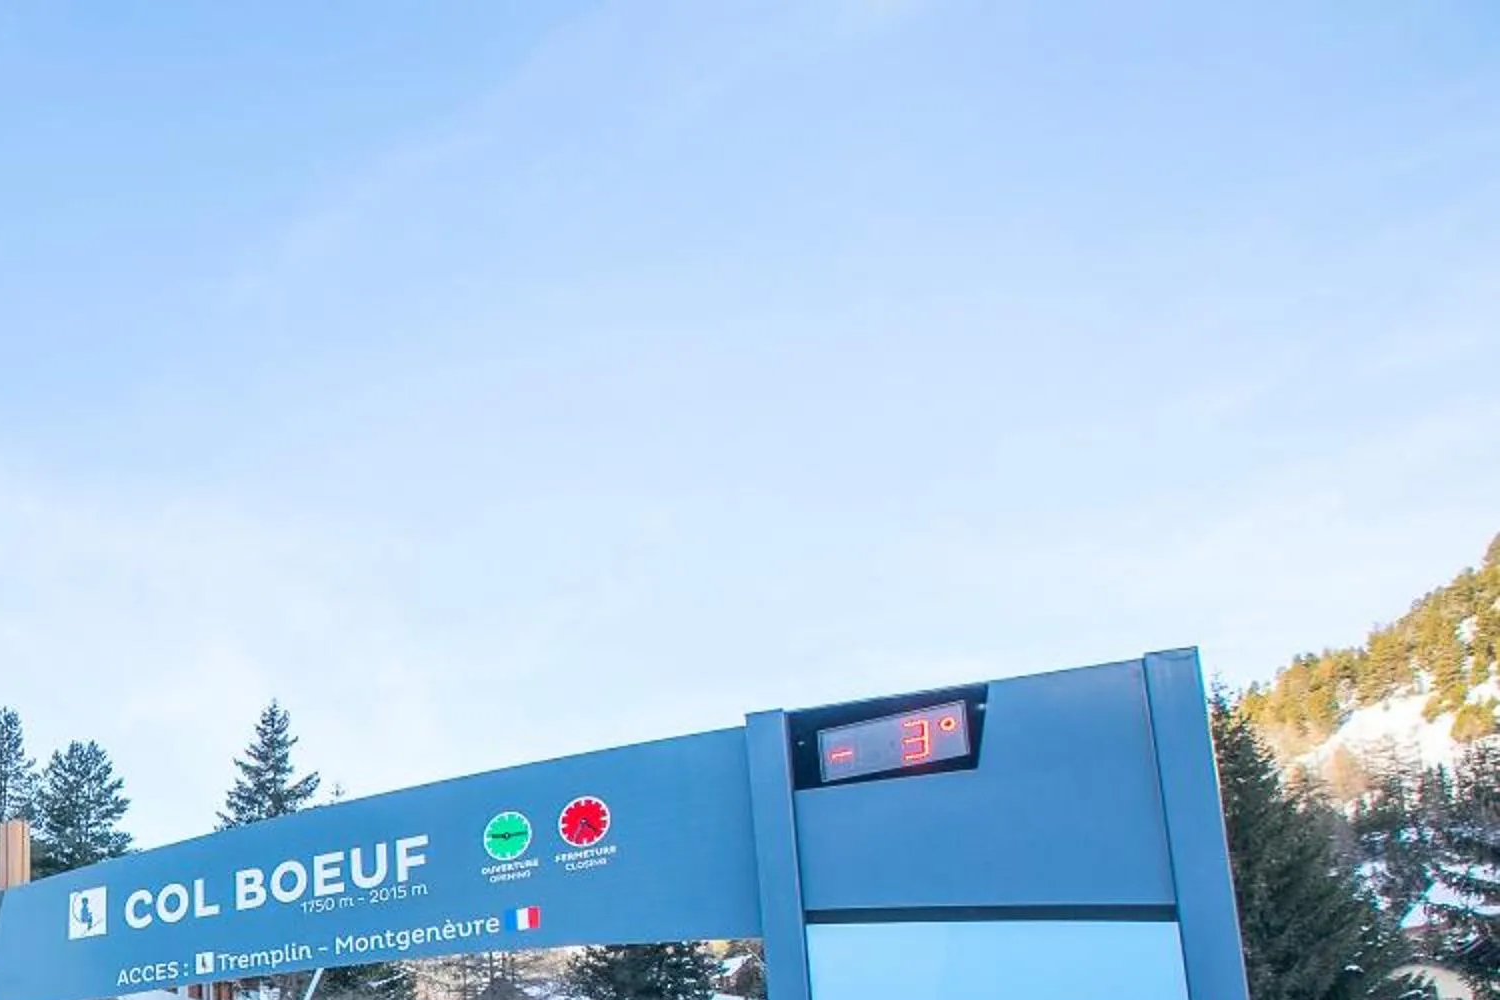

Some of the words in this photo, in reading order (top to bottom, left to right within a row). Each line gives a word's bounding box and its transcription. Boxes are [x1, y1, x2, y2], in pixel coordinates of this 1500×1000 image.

[481, 859, 539, 875] OUVERTURE
[555, 845, 617, 863] FERMETURE
[125, 877, 221, 930] COL
[235, 834, 430, 911] BOEUF
[301, 895, 336, 914] 1750
[338, 896, 355, 909] m
[369, 885, 408, 904] 2015
[410, 884, 429, 897] m
[117, 961, 179, 987] ACCES
[216, 943, 313, 972] Tremplin
[335, 917, 501, 955] Montgenèvre
